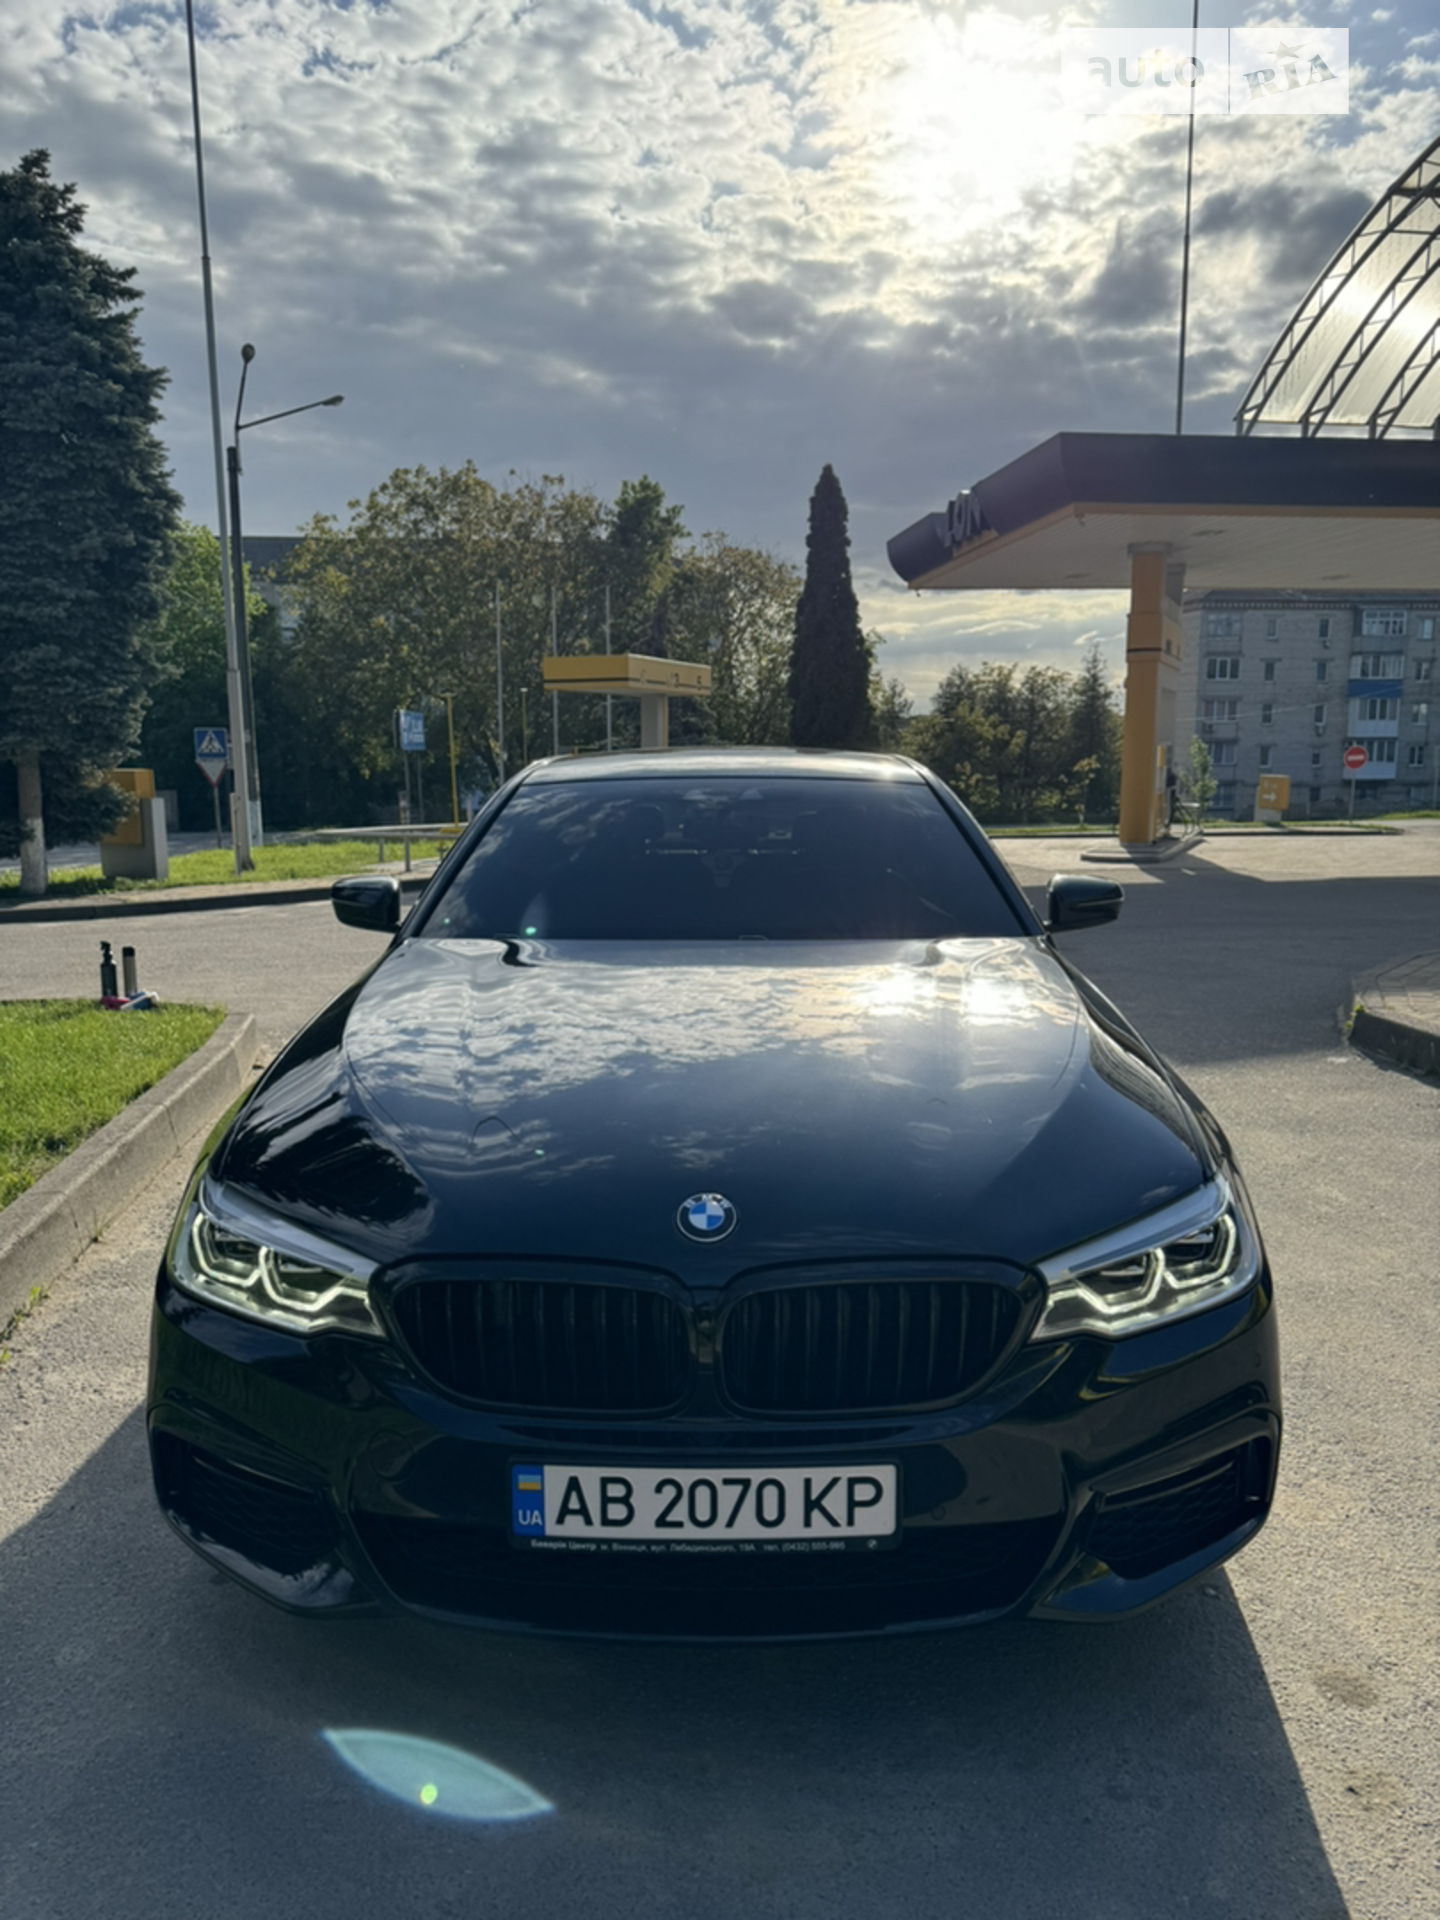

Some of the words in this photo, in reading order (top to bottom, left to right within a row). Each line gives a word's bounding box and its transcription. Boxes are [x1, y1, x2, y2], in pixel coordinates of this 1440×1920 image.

[518, 1510, 543, 1526] UA
[555, 1475, 636, 1528] AB
[653, 1477, 787, 1529] 2070
[803, 1476, 884, 1529] KP
